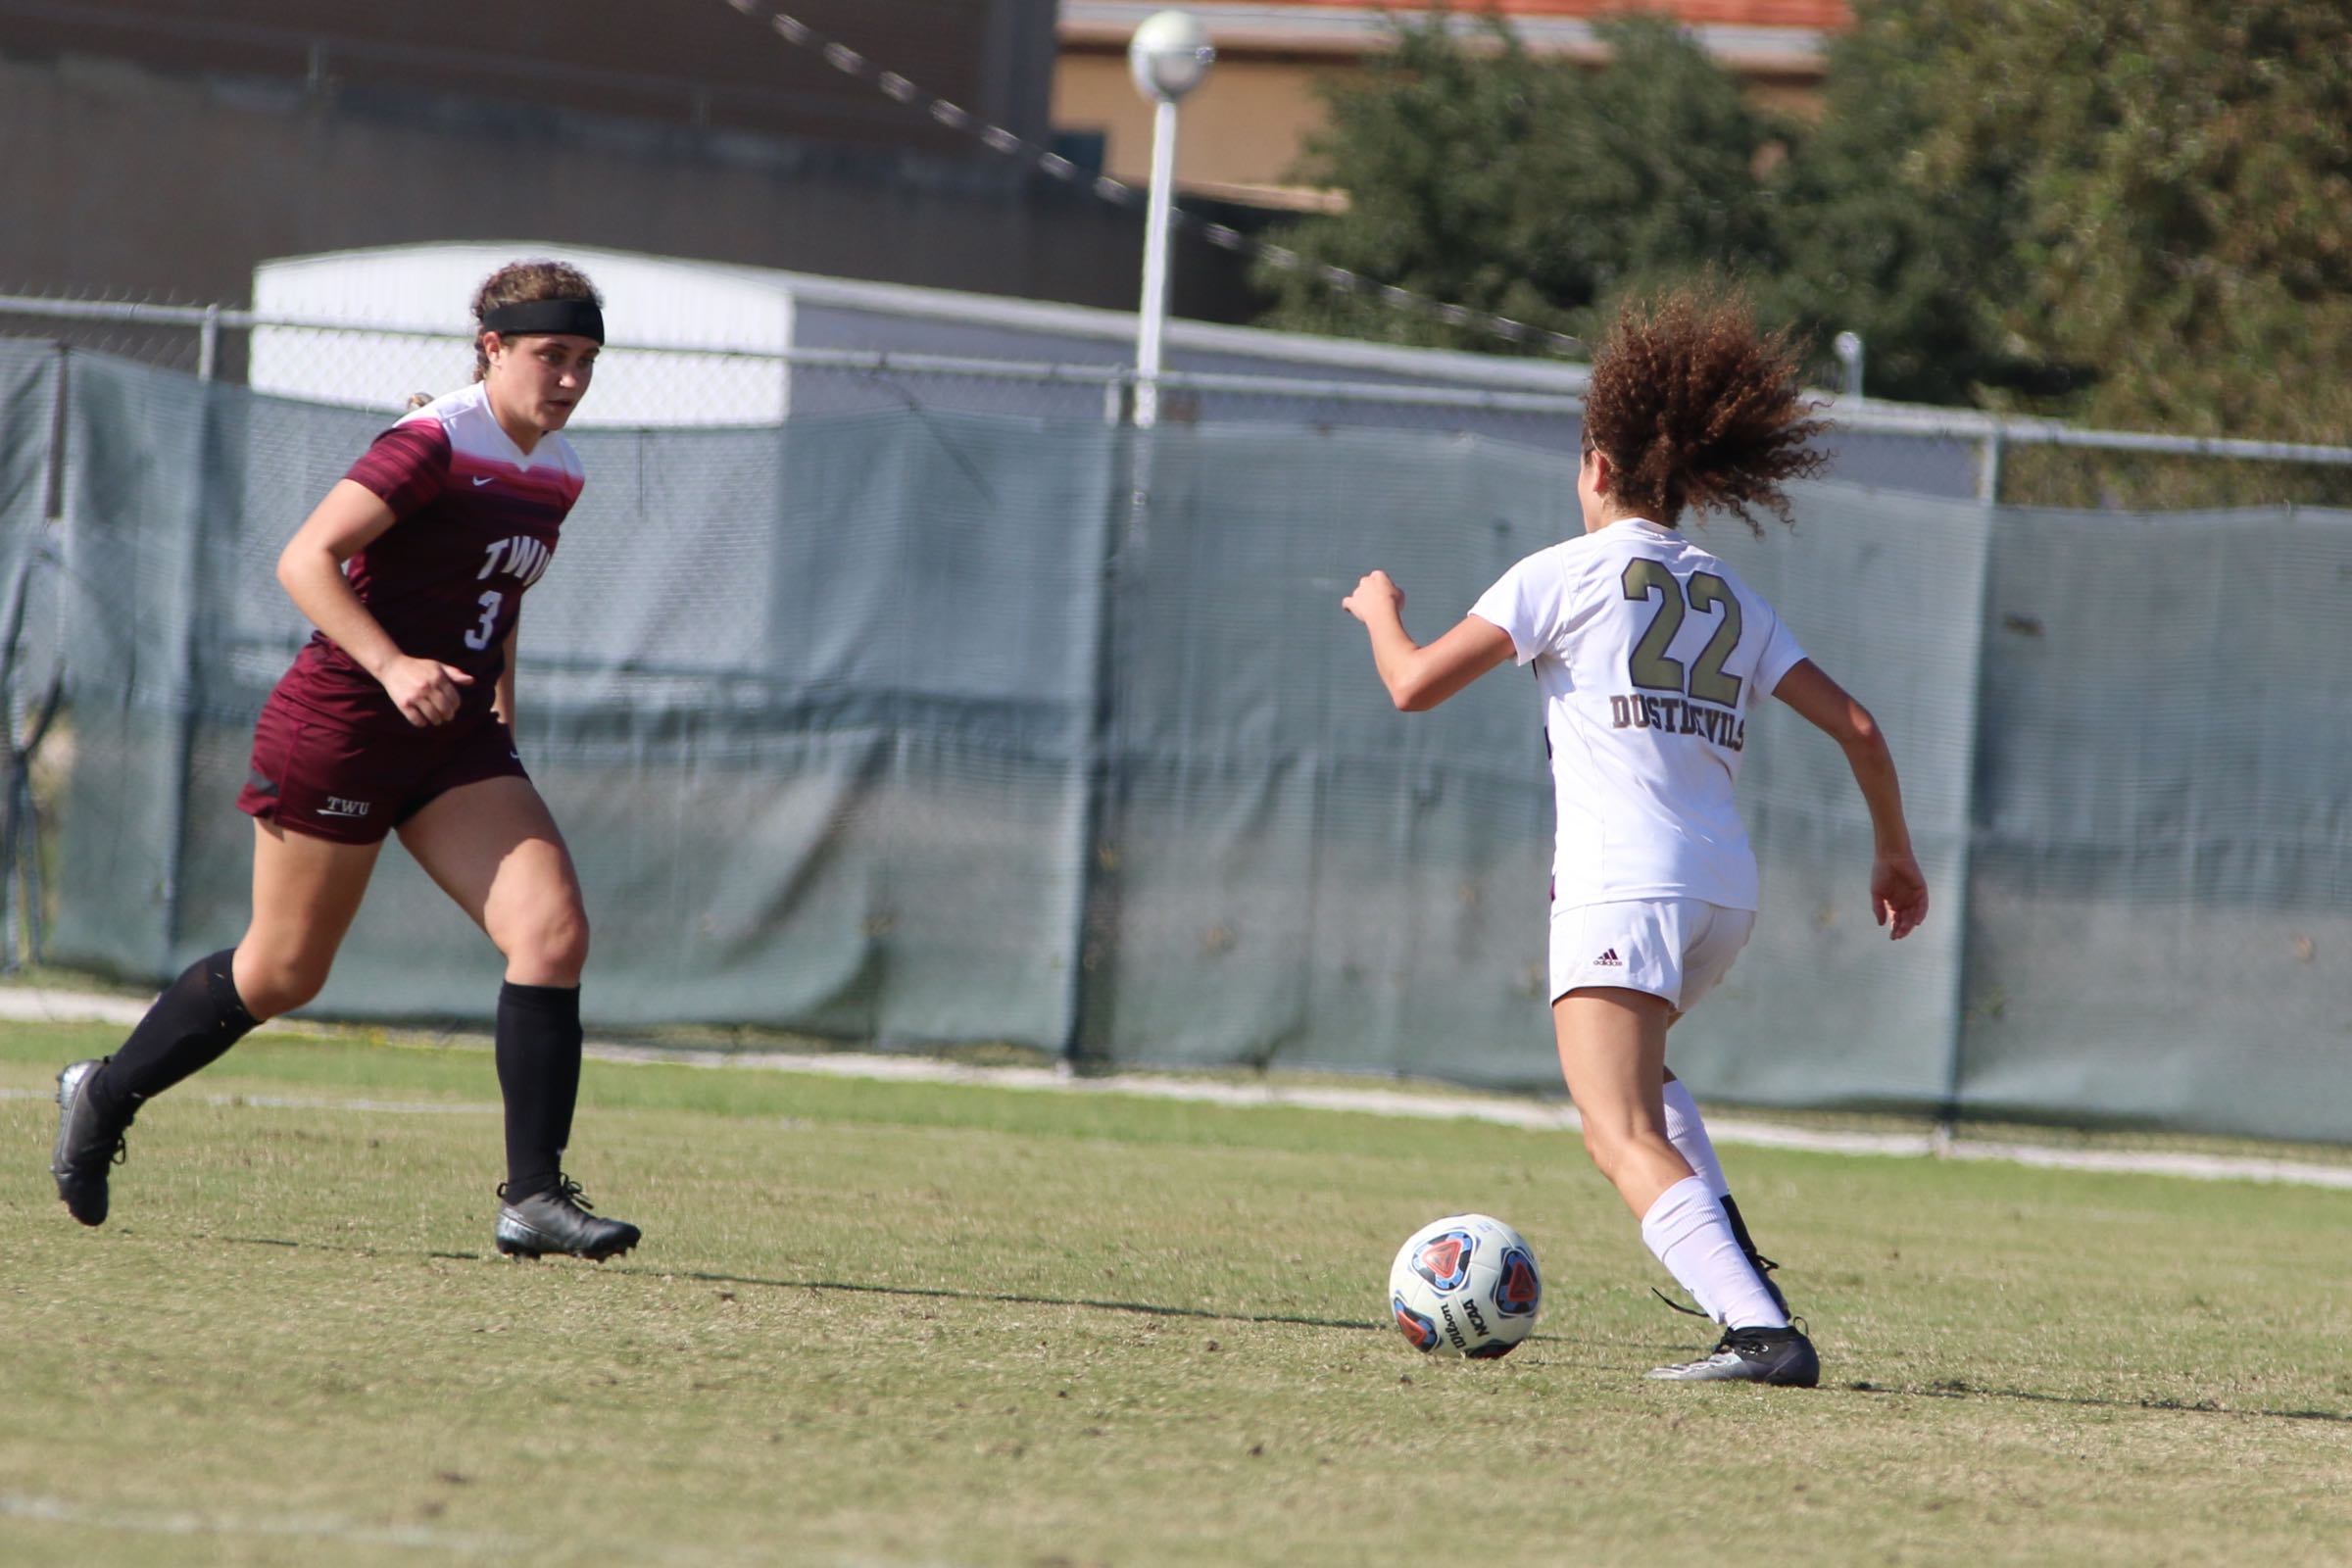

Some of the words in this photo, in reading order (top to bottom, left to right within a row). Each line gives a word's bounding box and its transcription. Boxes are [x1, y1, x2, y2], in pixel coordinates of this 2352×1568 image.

[476, 535, 551, 587] TWU
[465, 590, 503, 650] 3
[1621, 557, 1742, 709] 22
[326, 796, 369, 815] TWU
[1441, 1301, 1466, 1350] Wilson
[1462, 1298, 1490, 1337] NCAA
